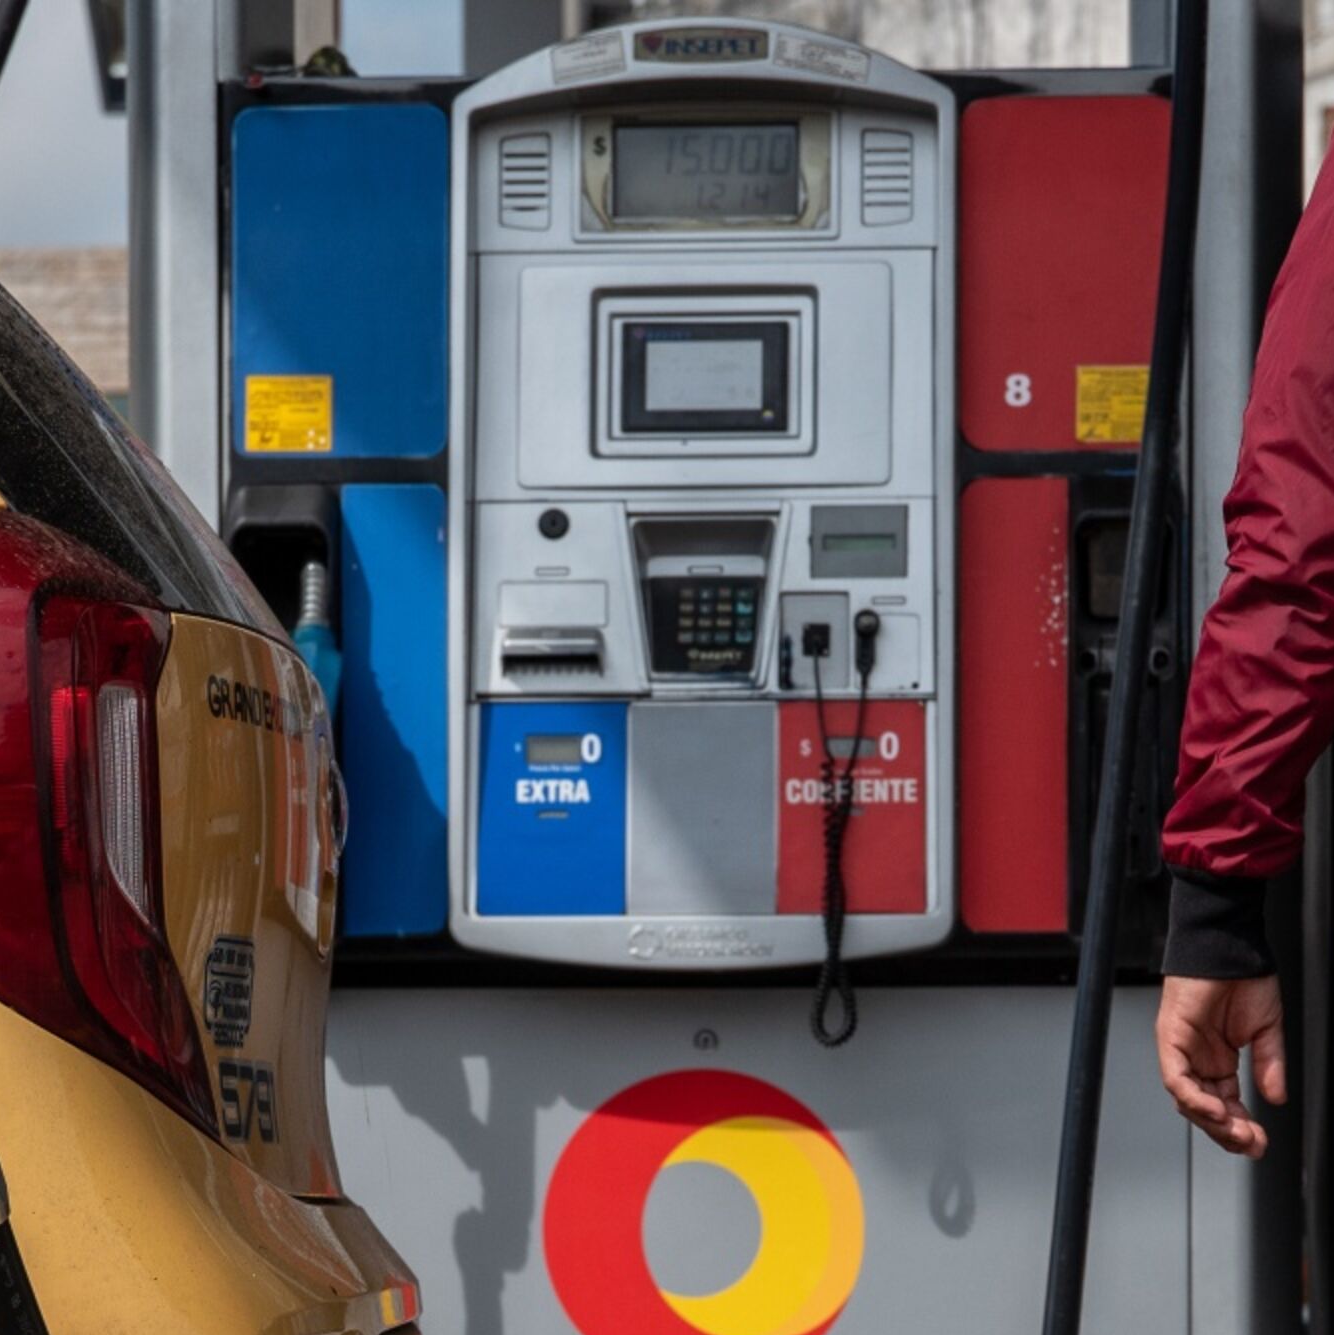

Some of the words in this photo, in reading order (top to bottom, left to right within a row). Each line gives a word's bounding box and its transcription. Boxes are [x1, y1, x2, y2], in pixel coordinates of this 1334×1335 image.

[1004, 373, 1032, 407] 8
[207, 674, 262, 726] GRAND
[580, 732, 603, 764] 0
[879, 731, 900, 761] 0
[515, 778, 592, 804] EXTRA
